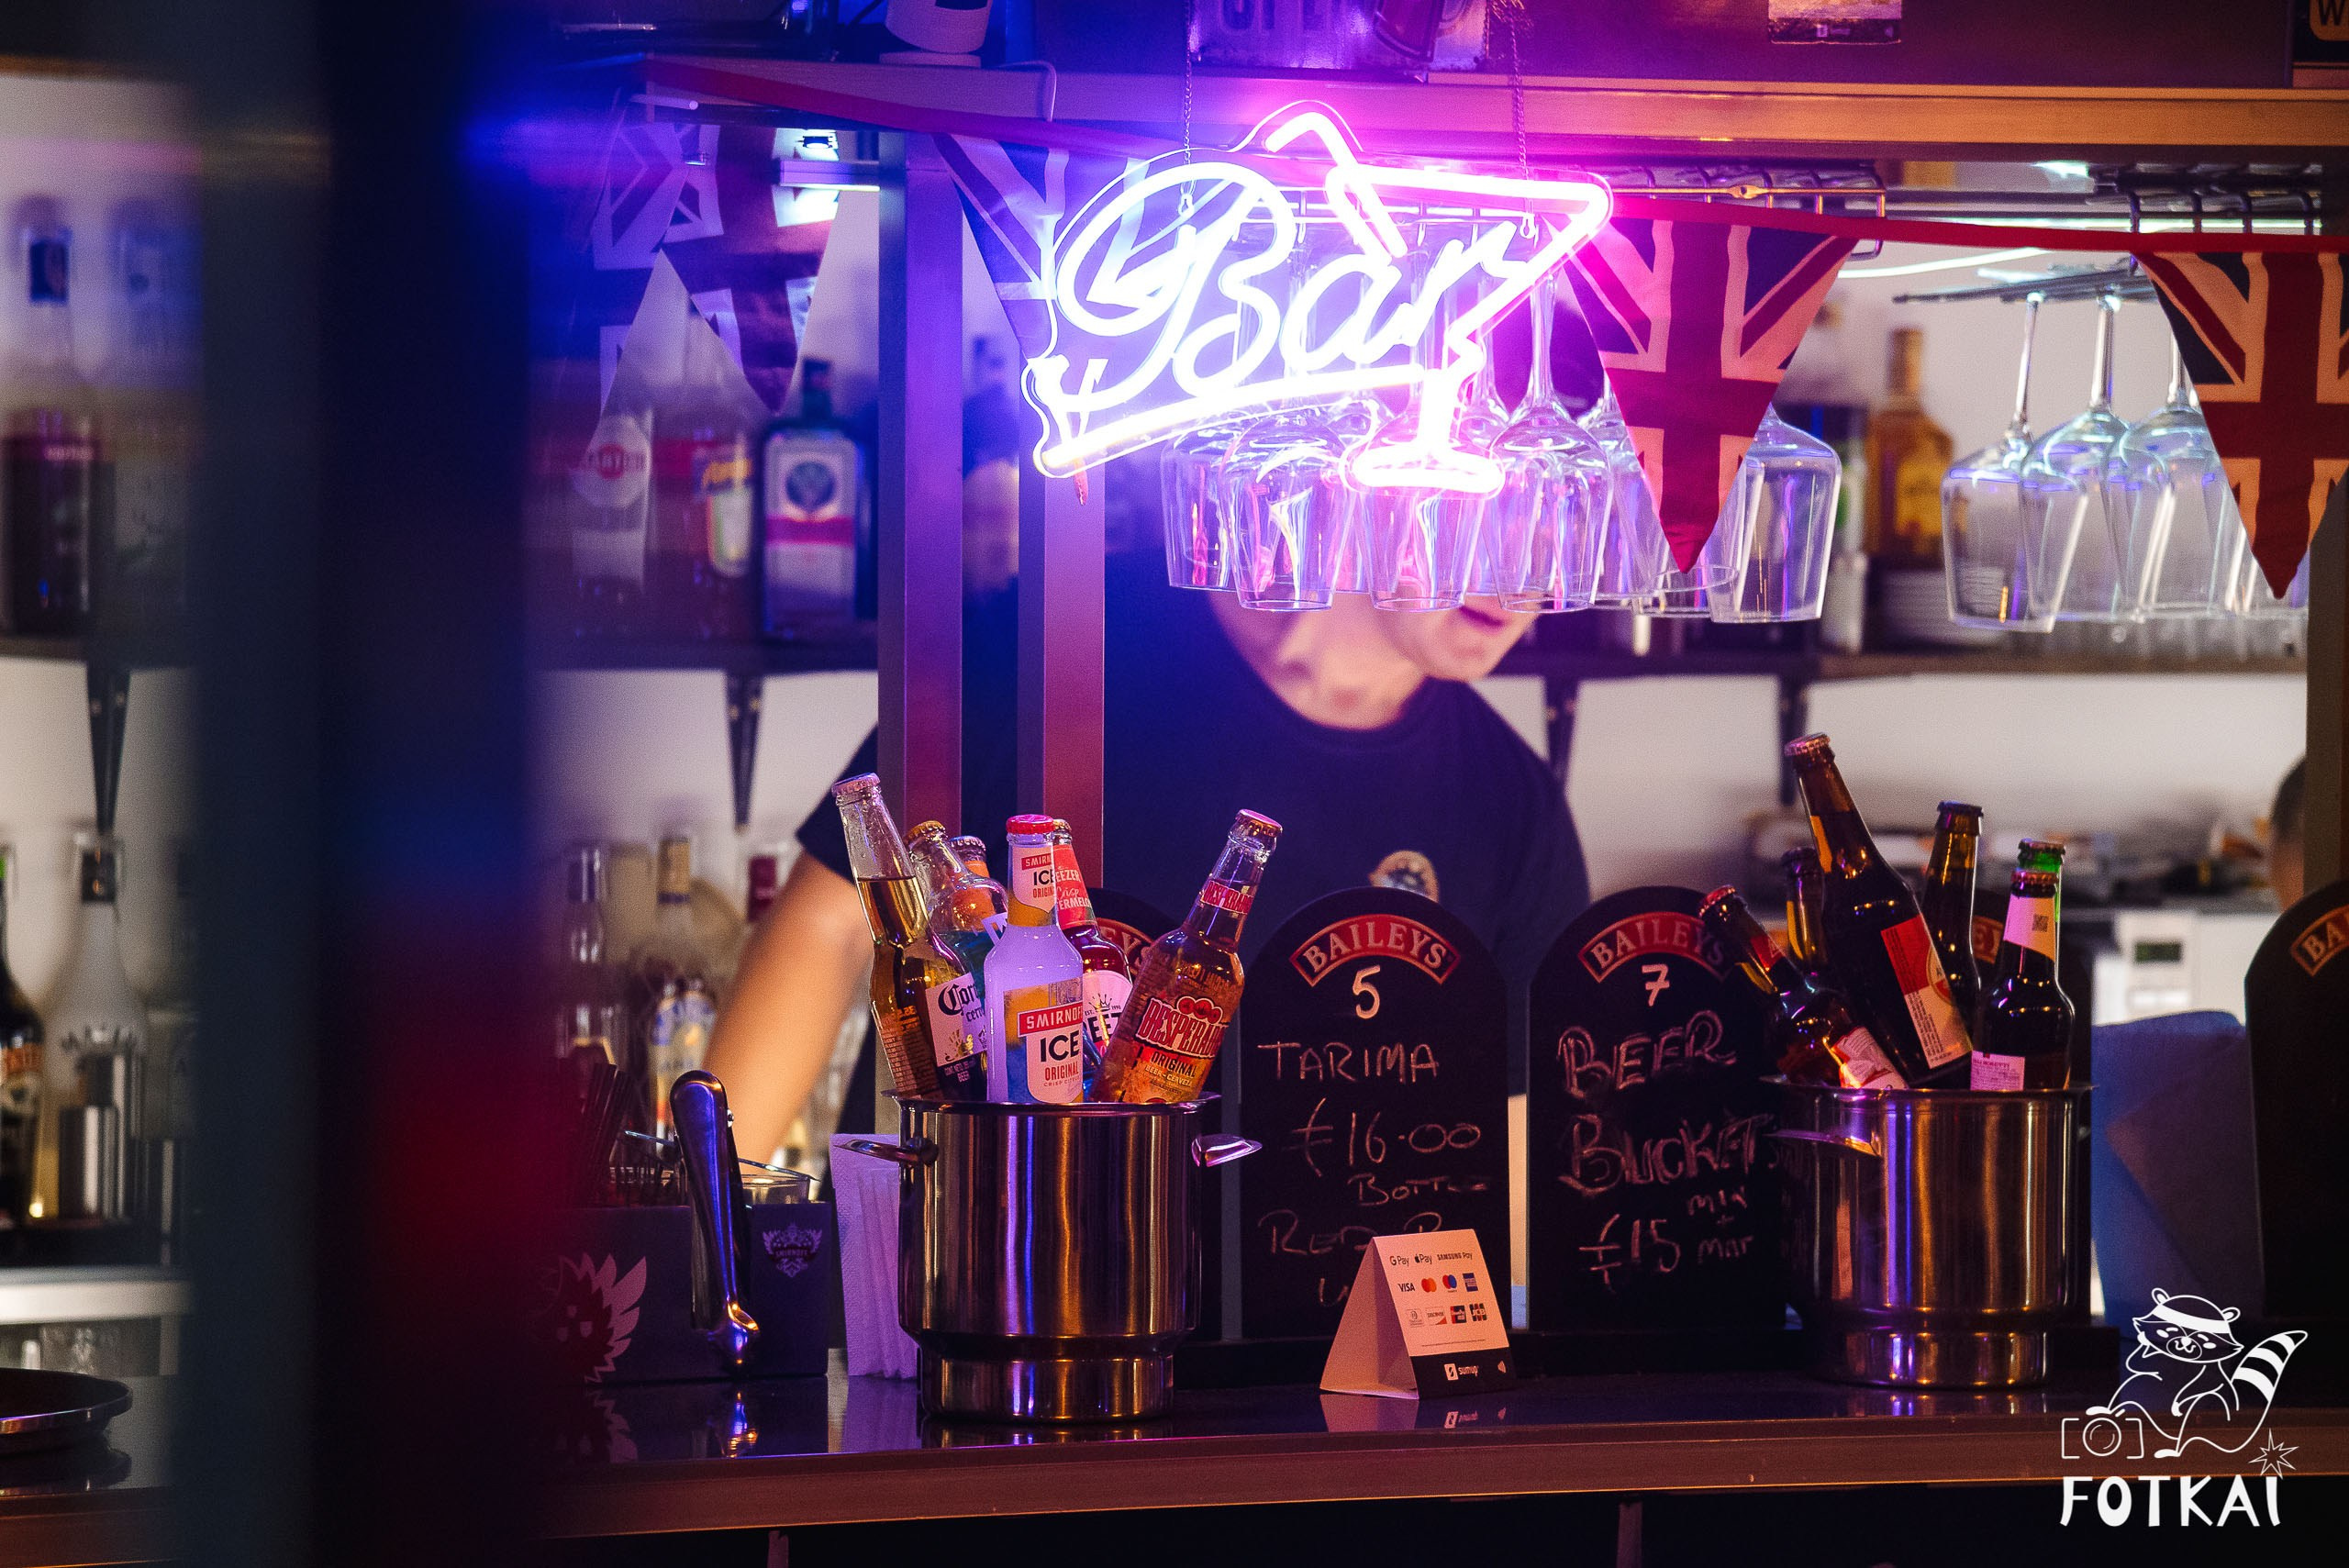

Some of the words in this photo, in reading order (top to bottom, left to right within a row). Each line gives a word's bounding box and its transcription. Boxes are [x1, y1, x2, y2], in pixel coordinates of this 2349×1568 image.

[1039, 161, 1527, 413] Bar
[1303, 921, 1447, 973] BAILEYS
[1590, 918, 1724, 969] BAILEYS
[1352, 964, 1381, 1020] 5
[1642, 962, 1670, 1007] 7
[1040, 1029, 1080, 1062] ICE
[1151, 1051, 1197, 1078] ORIGINAL
[1257, 1040, 1440, 1084] TARIMA
[1556, 1009, 1737, 1098] BEER
[1044, 1062, 1078, 1081] ORIGINAL
[1437, 1252, 1462, 1262] SAMSUNG
[1397, 1283, 1416, 1292] VISA
